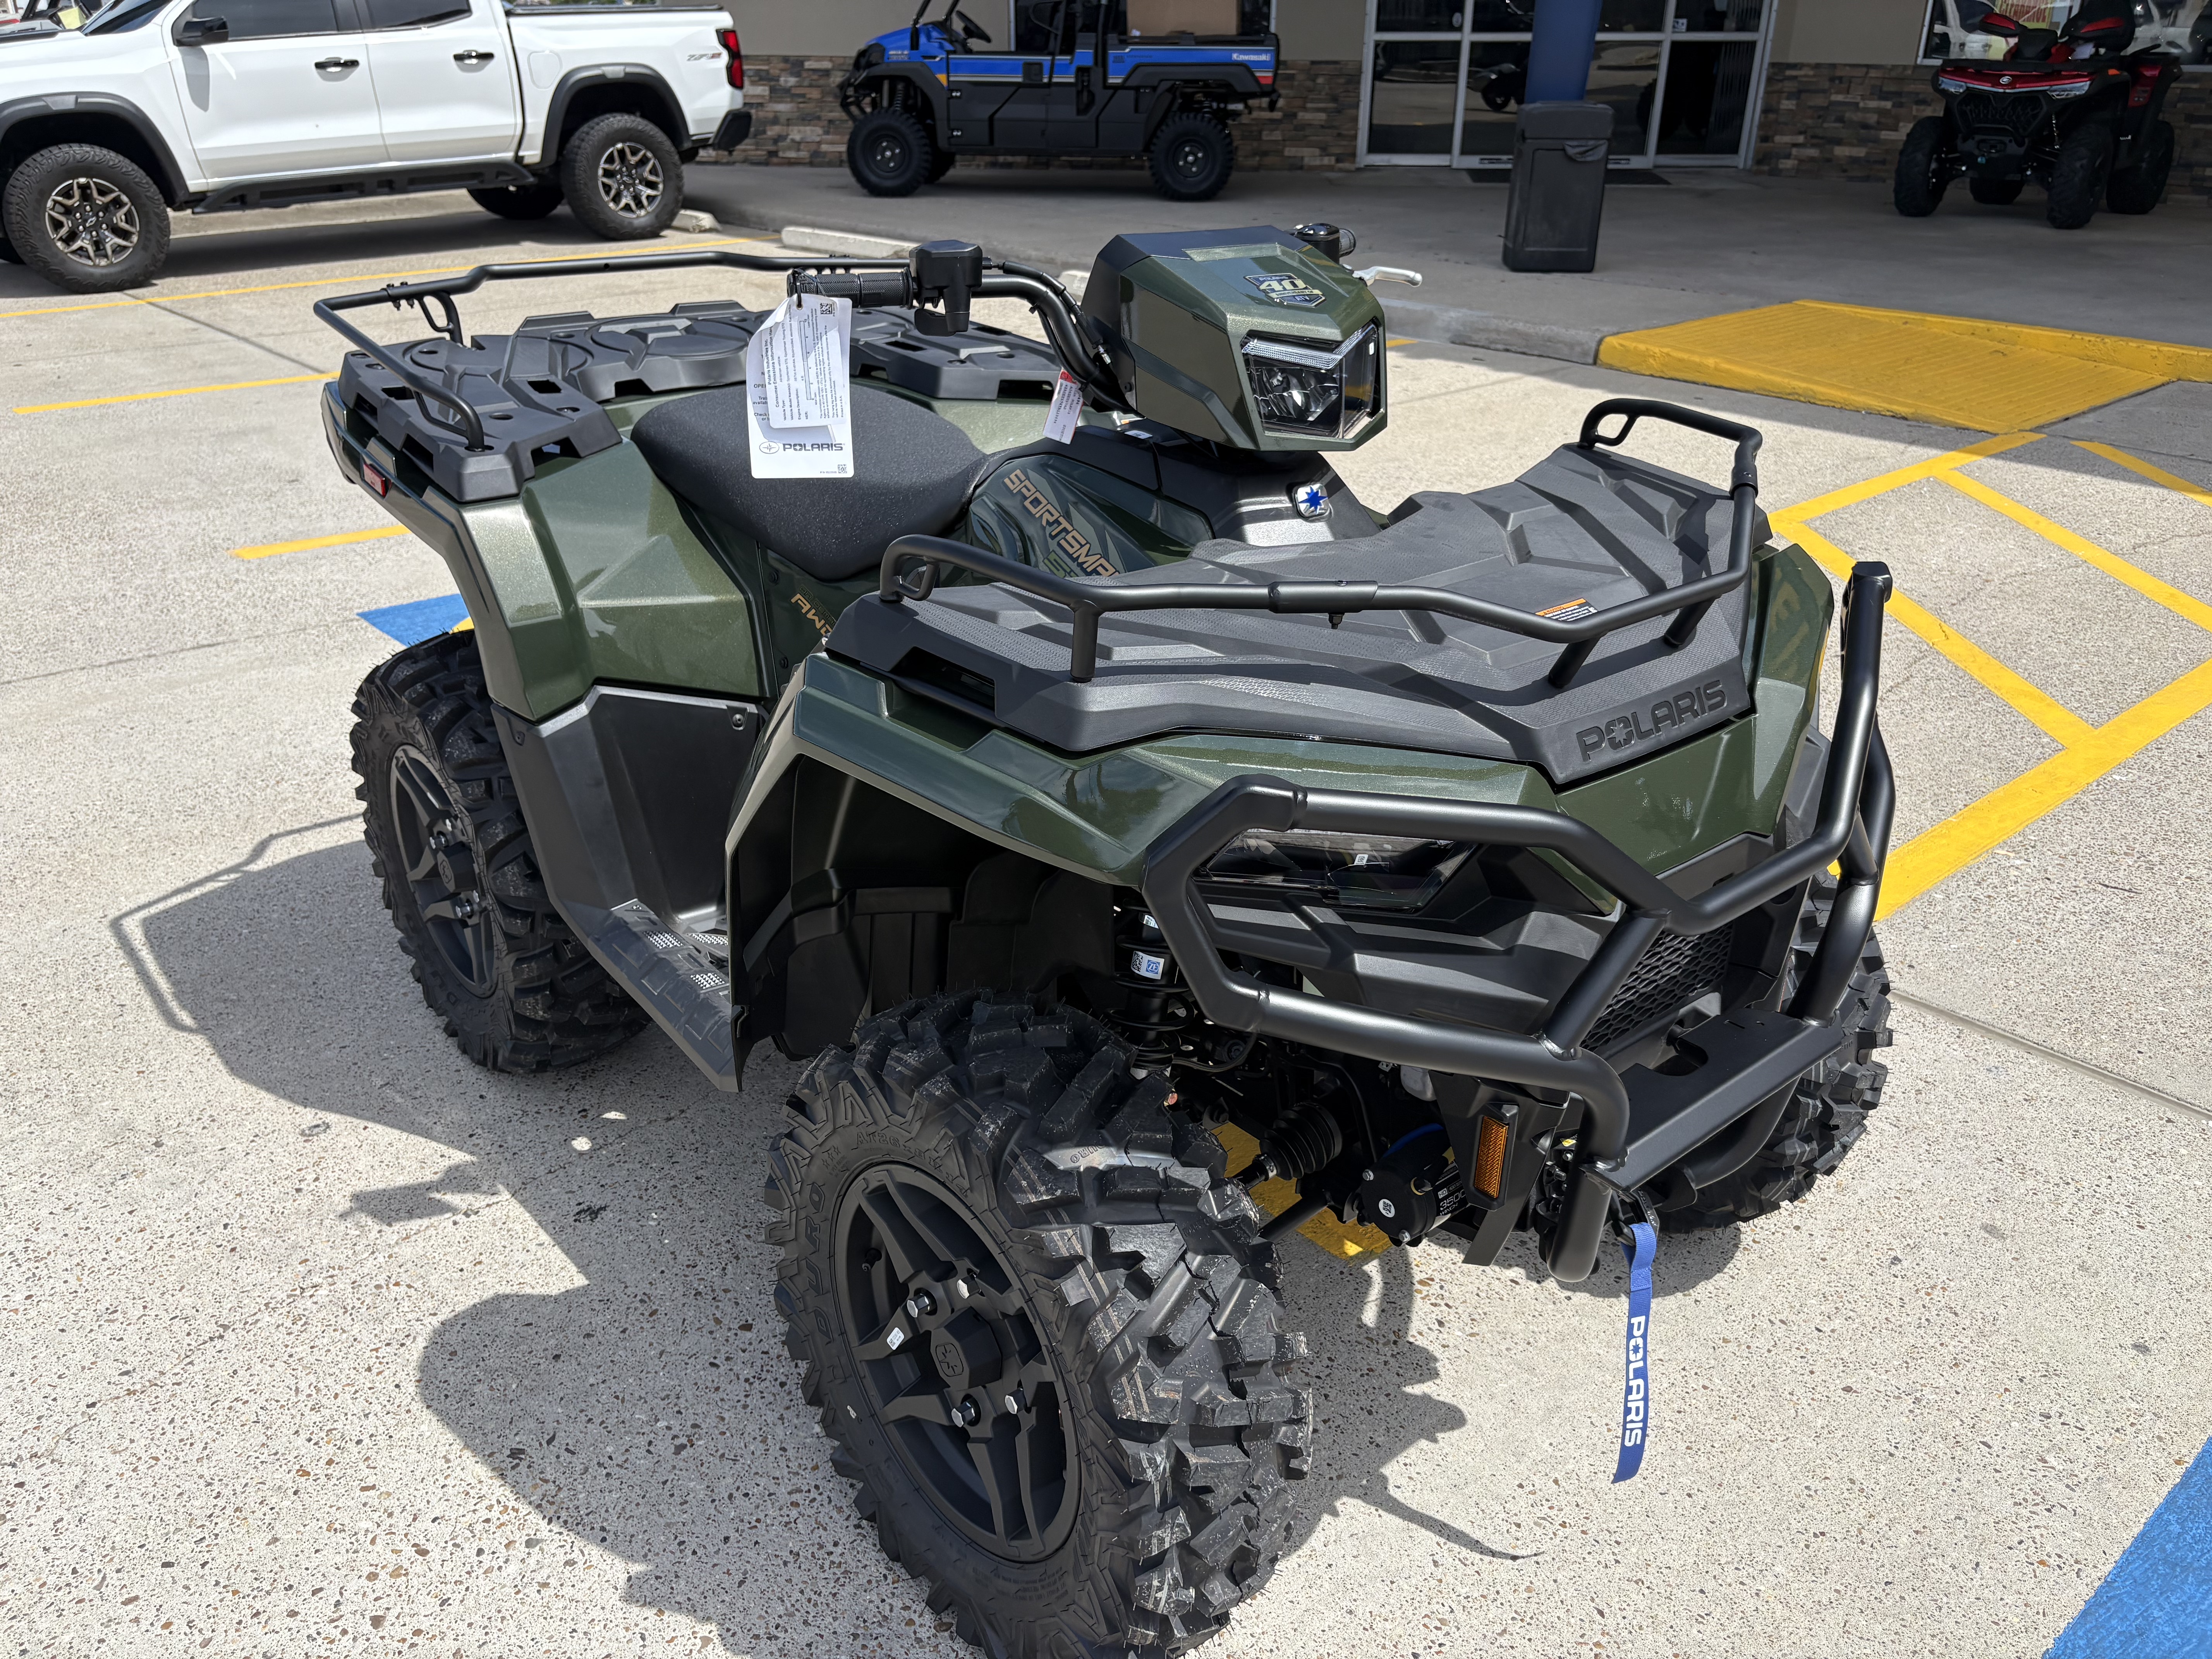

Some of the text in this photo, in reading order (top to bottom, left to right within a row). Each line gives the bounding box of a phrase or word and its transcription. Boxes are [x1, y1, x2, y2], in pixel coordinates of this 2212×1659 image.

[782, 443, 843, 451] POLARIS
[1003, 469, 1120, 577] SPORTSMA
[1576, 680, 1728, 763] POLARIS
[1148, 963, 1158, 971] ZF
[805, 1182, 834, 1343] DURO
[1624, 1315, 1646, 1447] POLARIS
